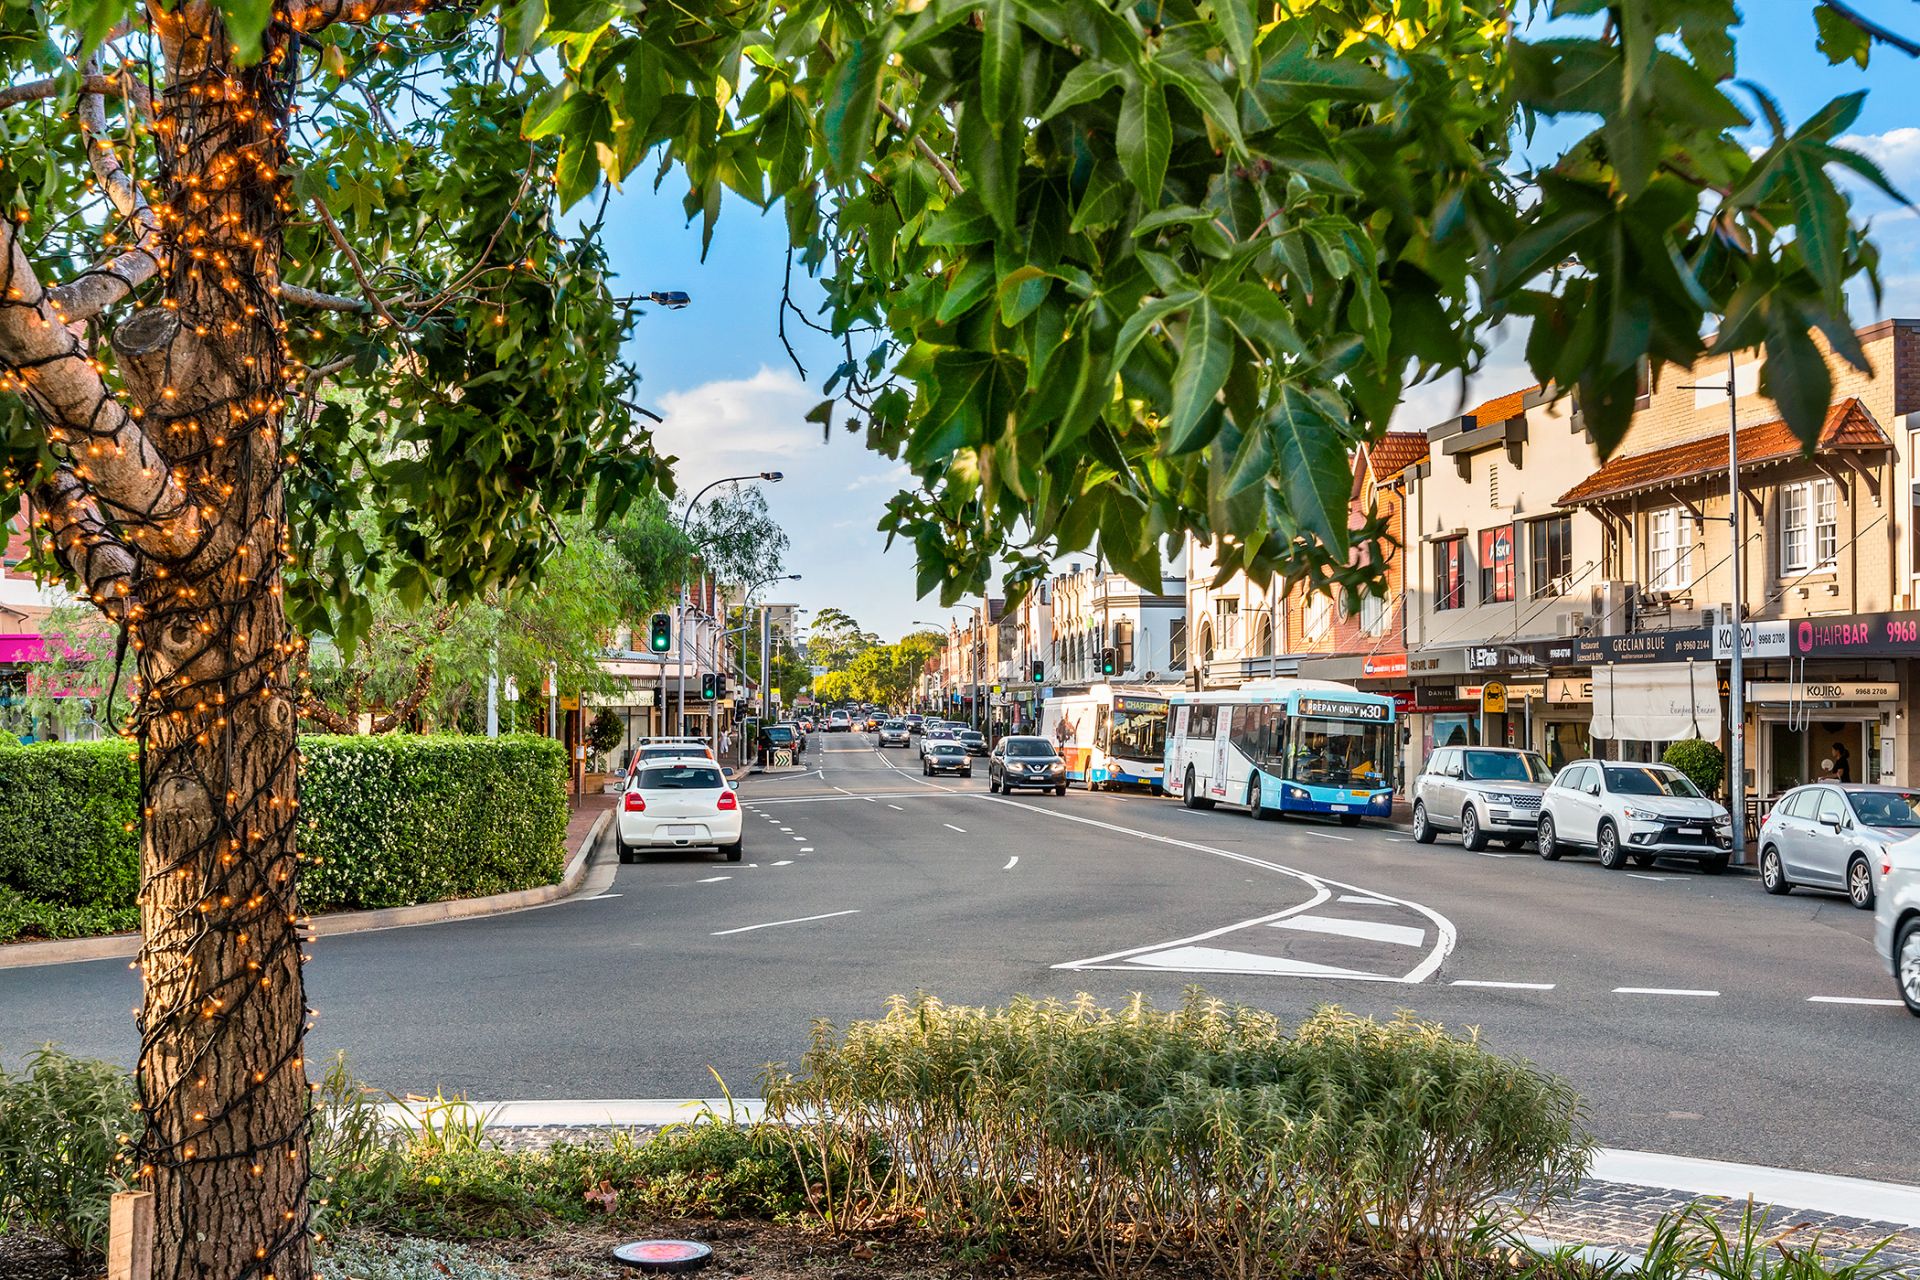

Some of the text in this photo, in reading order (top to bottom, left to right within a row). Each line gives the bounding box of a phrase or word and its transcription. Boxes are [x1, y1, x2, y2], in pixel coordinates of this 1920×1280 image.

[1719, 626, 1786, 649] KORO 9968 2708
[1815, 620, 1917, 647] HAIRBAR 9968
[1612, 636, 1665, 652] GRECIAN BLUE
[1806, 685, 1888, 698] KOJIRO 9968 2708
[1307, 702, 1381, 719] PREPAY ONLY M30
